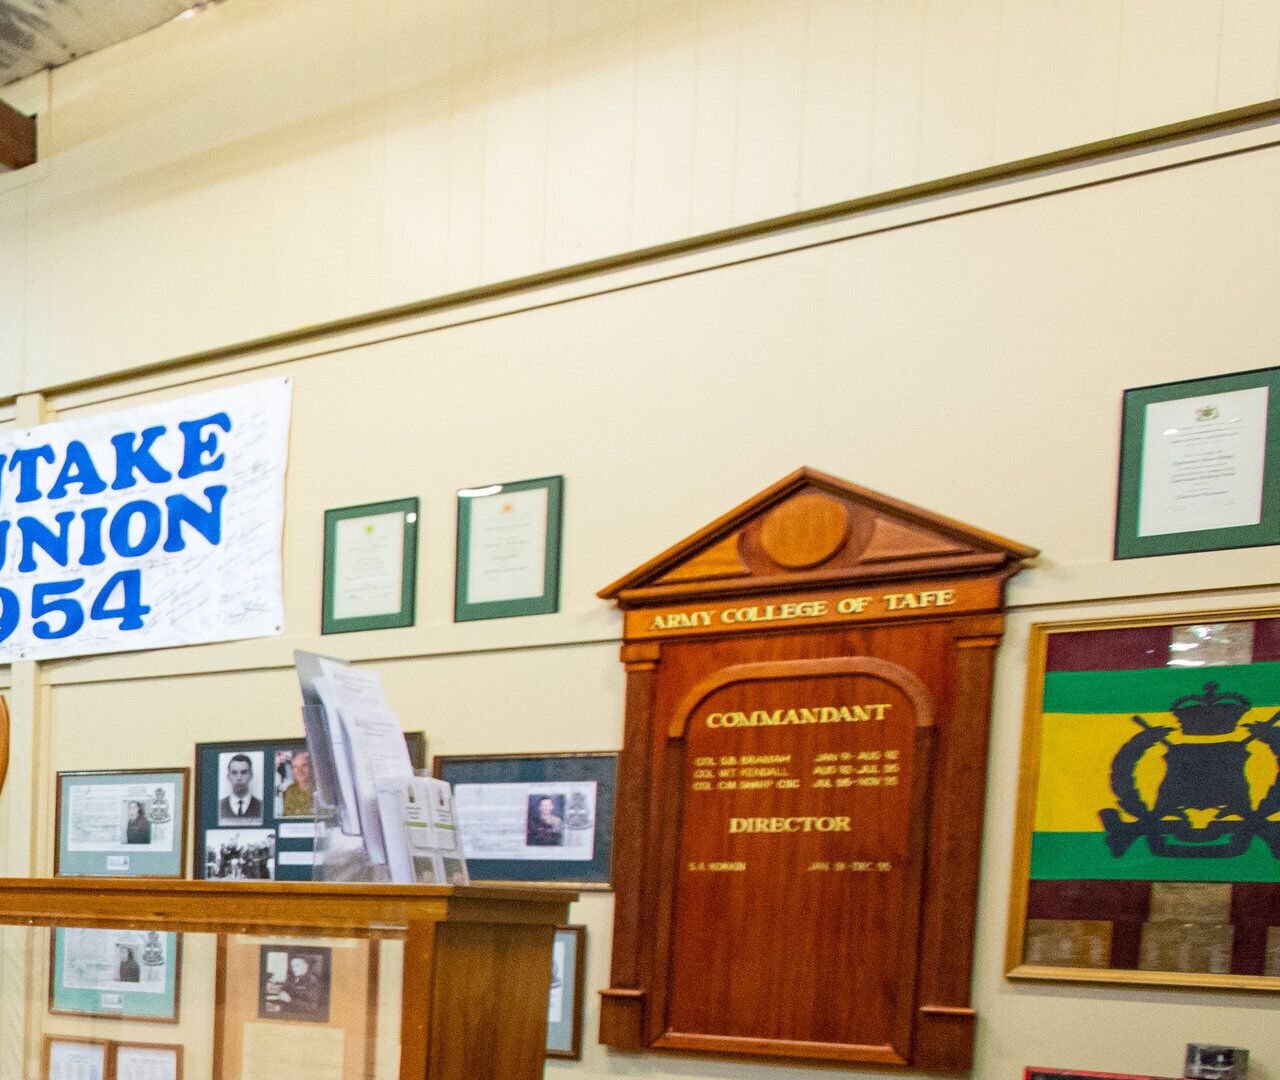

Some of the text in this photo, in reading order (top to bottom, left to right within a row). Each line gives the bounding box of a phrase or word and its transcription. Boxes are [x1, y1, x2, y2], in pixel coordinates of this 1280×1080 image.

[650, 588, 956, 630] ARMY COLLEGE OF TAFE
[705, 703, 892, 729] COMMANDANT
[729, 816, 852, 833] DIRECTOR
